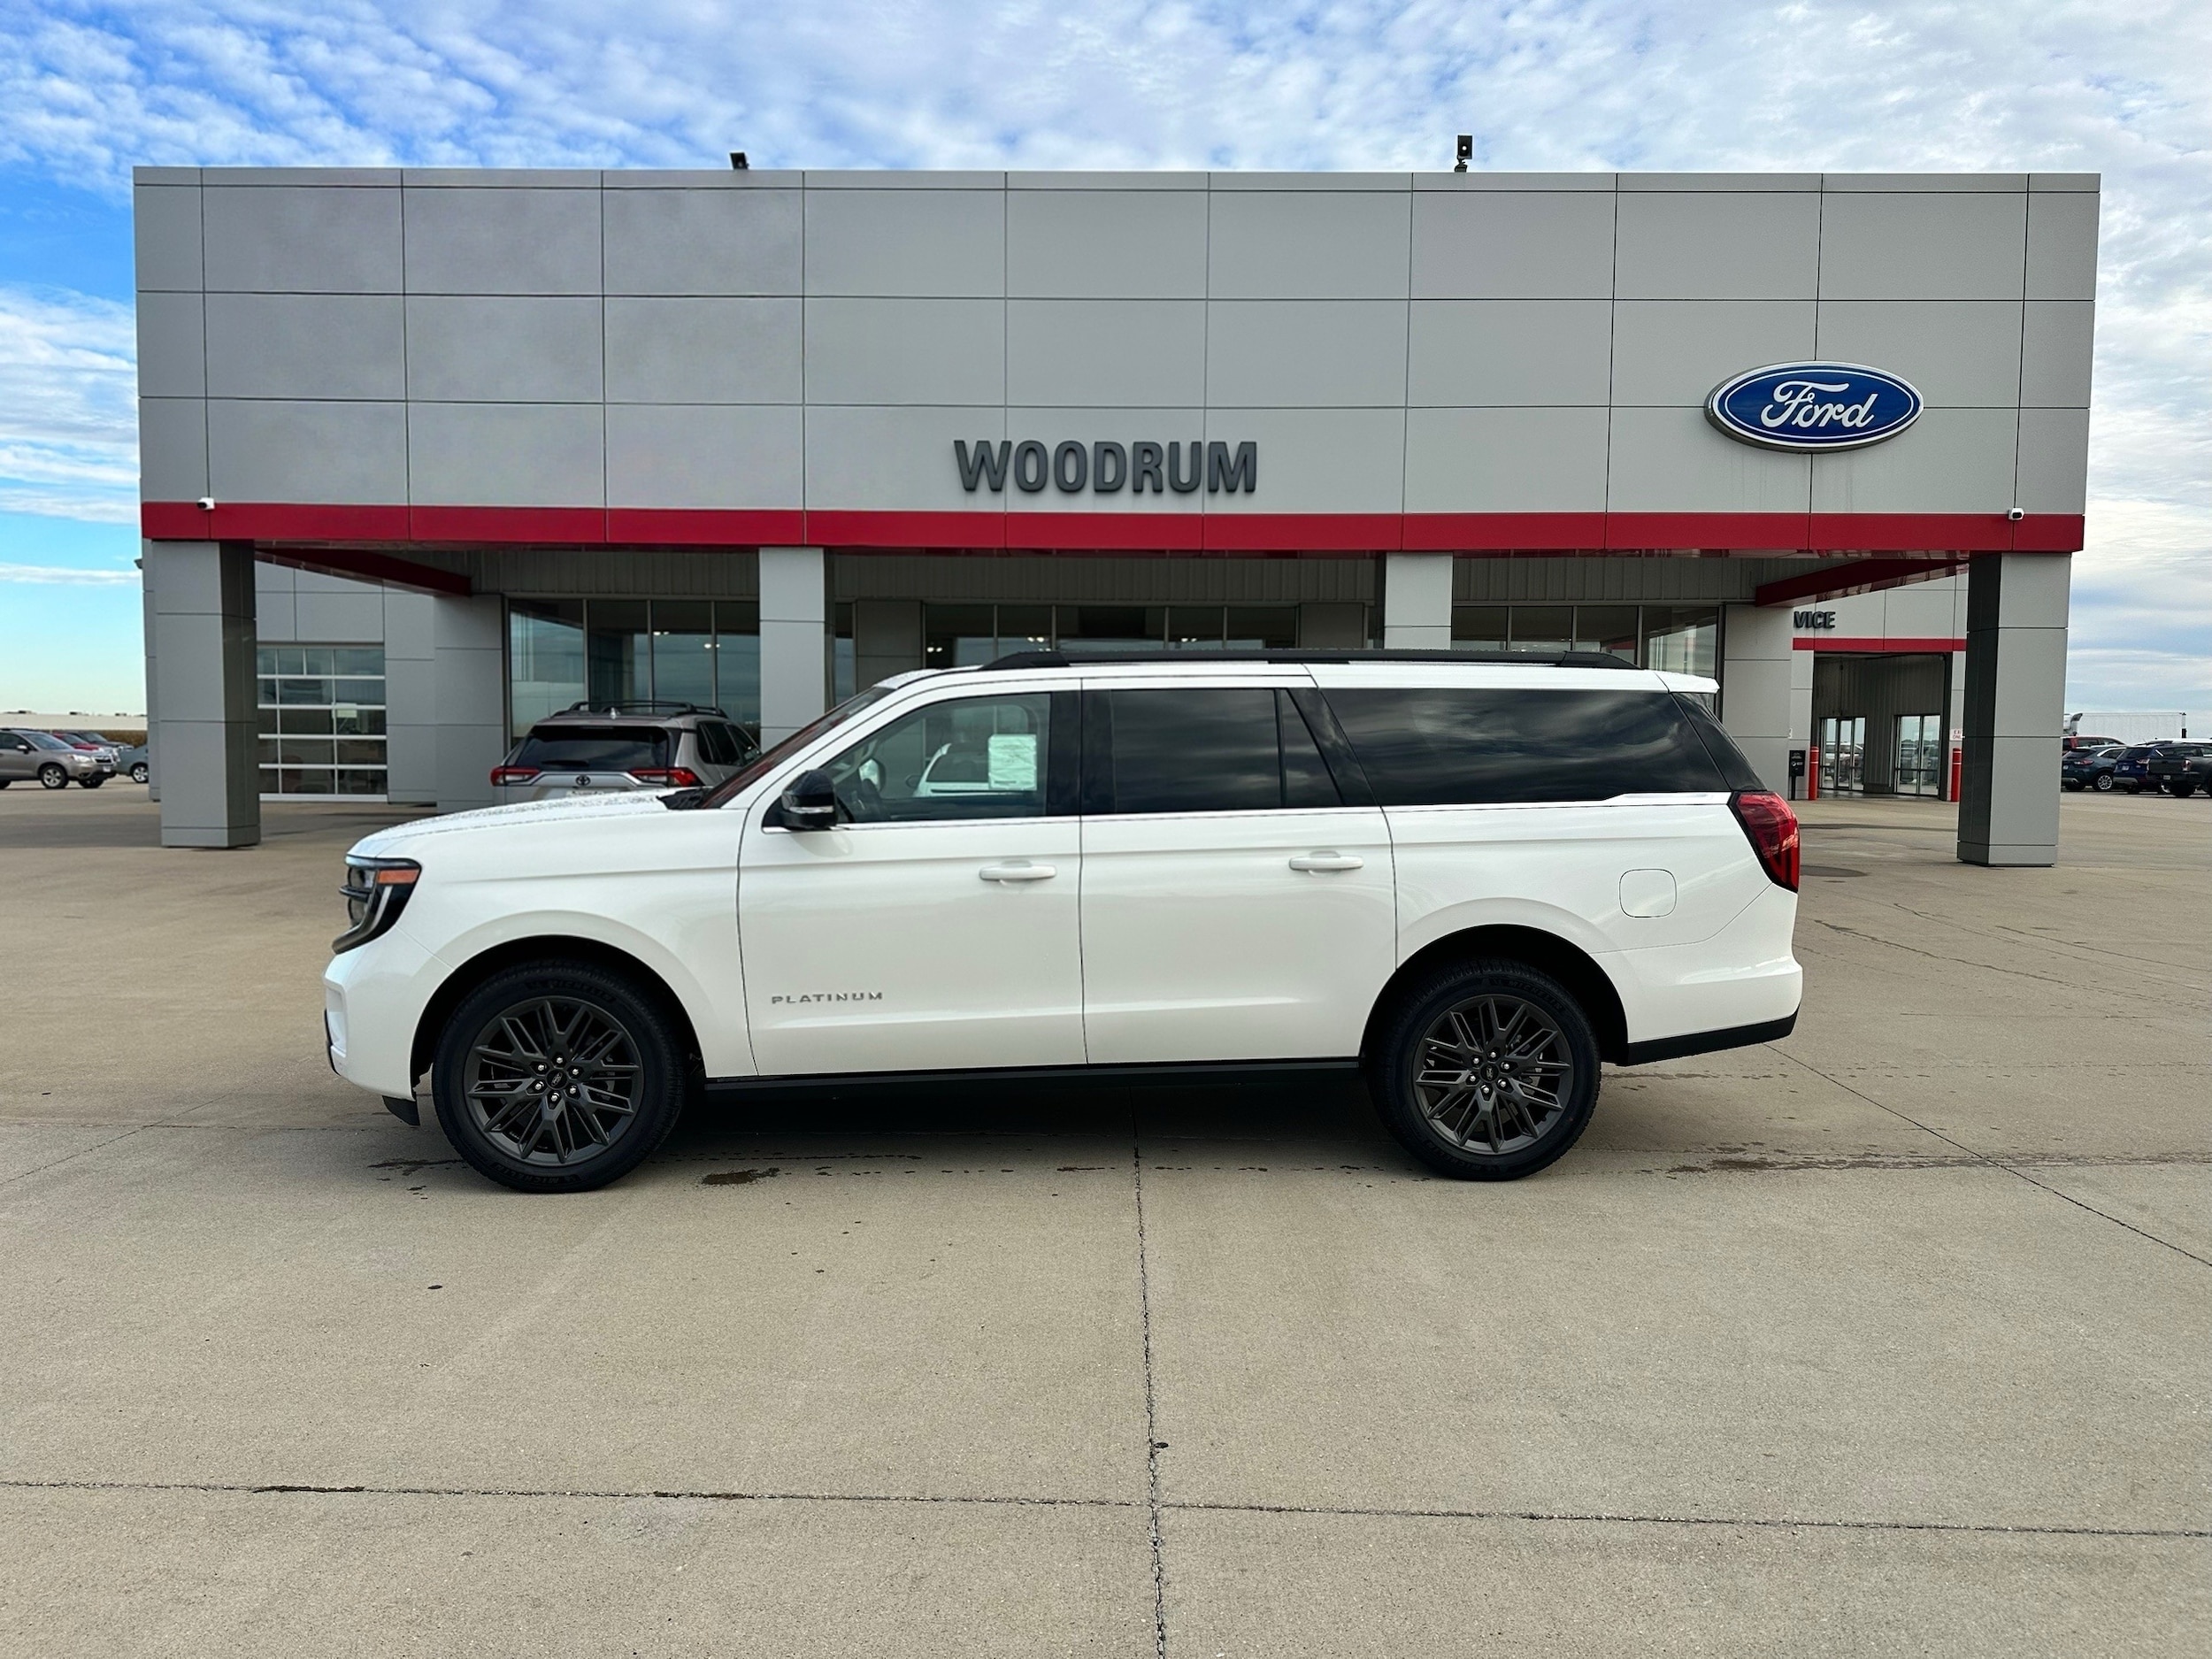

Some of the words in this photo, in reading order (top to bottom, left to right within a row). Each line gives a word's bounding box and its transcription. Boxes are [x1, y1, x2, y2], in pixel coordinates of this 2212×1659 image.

[1761, 380, 1878, 428] Ford
[954, 440, 1257, 494] WOODRUM
[1793, 611, 1836, 629] VICE
[772, 991, 883, 1004] PLATINUM
